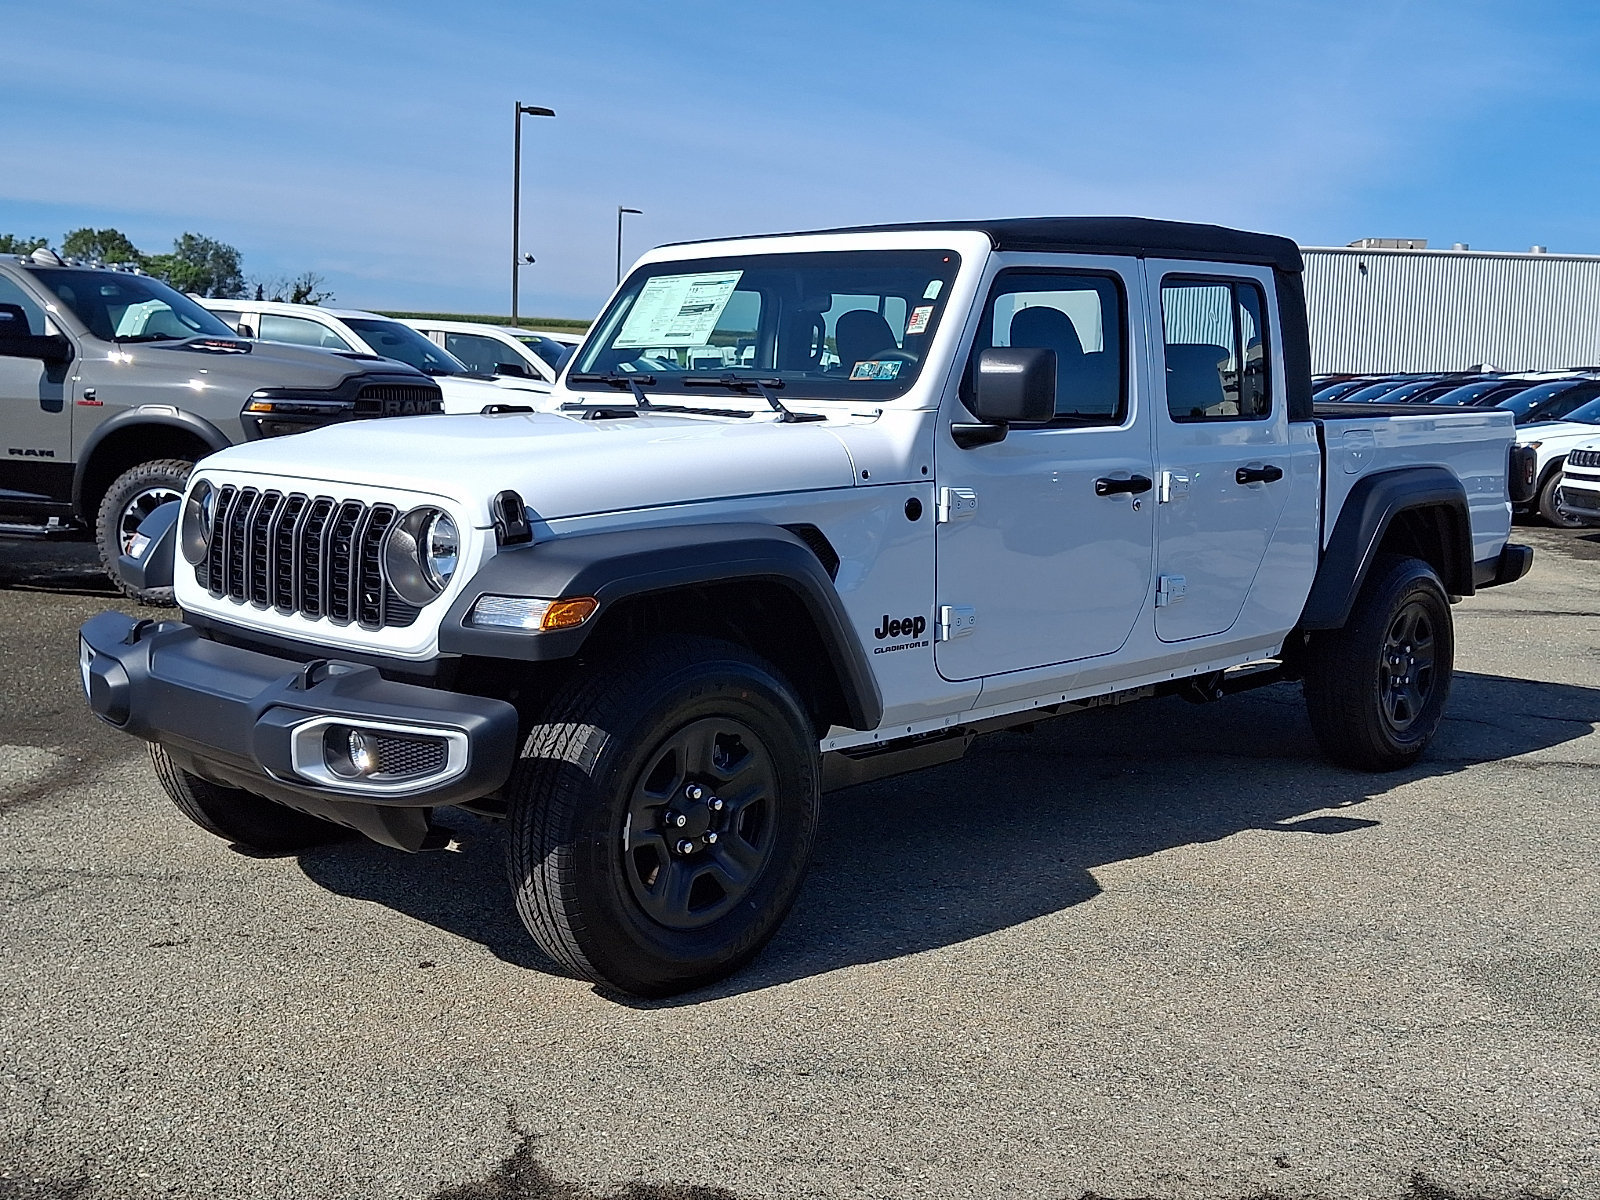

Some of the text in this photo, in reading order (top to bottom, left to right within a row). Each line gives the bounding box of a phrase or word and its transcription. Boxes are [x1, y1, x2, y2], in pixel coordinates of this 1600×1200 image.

[385, 400, 430, 415] RAM
[8, 447, 55, 458] RAM
[874, 614, 926, 640] Jeep
[873, 641, 921, 655] GLADIATOR
